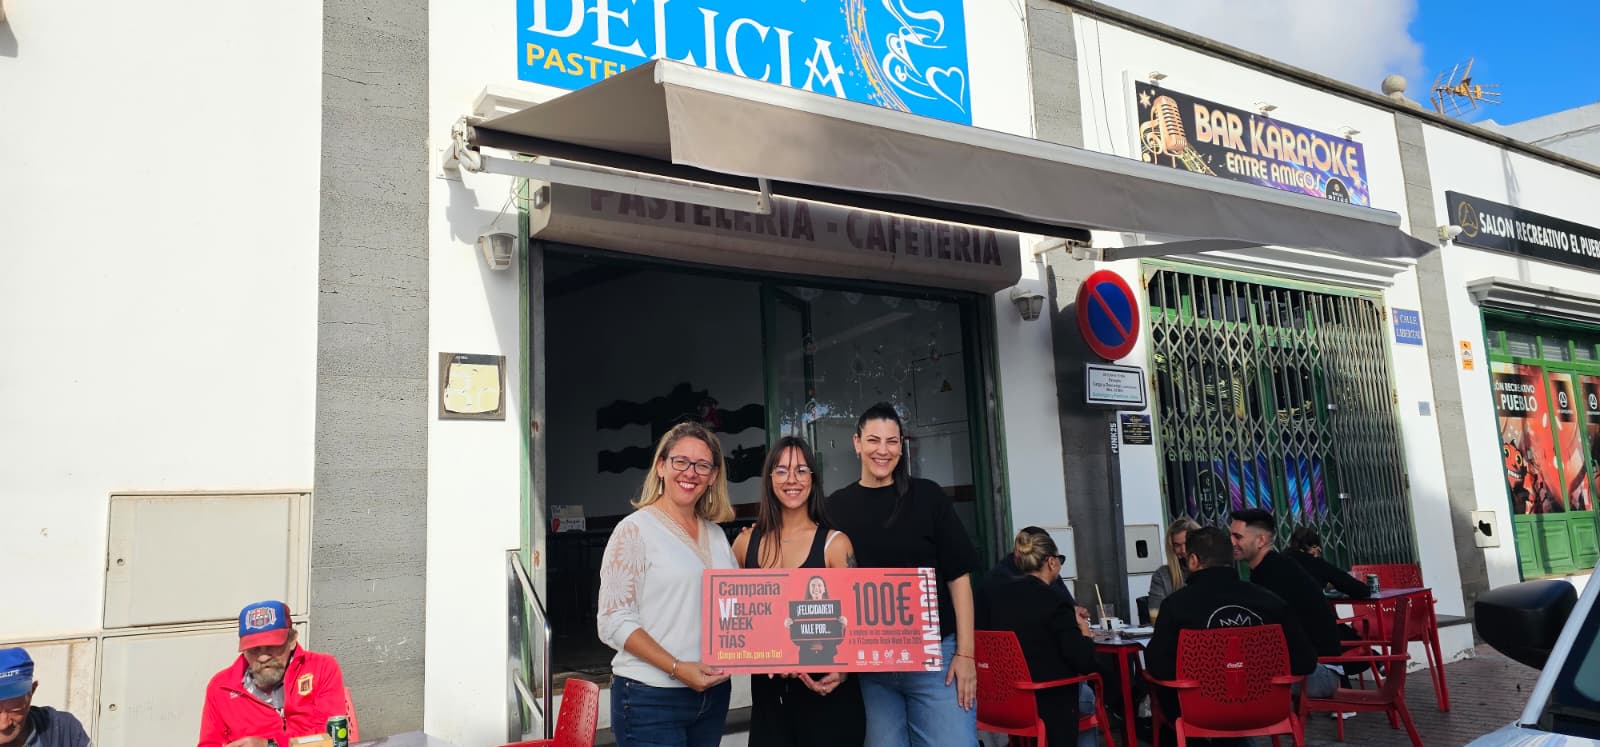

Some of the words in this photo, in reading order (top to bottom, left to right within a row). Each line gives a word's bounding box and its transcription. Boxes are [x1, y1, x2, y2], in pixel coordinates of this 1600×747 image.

[1193, 103, 1247, 152] BAR
[1249, 115, 1360, 181] KARAOKE
[1226, 151, 1268, 179] ENTRE
[1270, 162, 1321, 190] AMIGOS
[846, 208, 1001, 266] CAFETERIA
[1480, 211, 1515, 239] SALON
[1515, 221, 1569, 252] RECREATIVO
[1569, 233, 1581, 254] EL
[1399, 313, 1418, 325] CALLE
[1504, 382, 1535, 394] RECREATIVO
[1501, 394, 1538, 412] PUEBLO
[718, 581, 780, 598] Campaña
[734, 602, 772, 616] BLACK
[853, 581, 914, 626] 100€
[718, 617, 753, 631] WEEK
[800, 623, 815, 635] VALE
[718, 631, 746, 649] TÍAS
